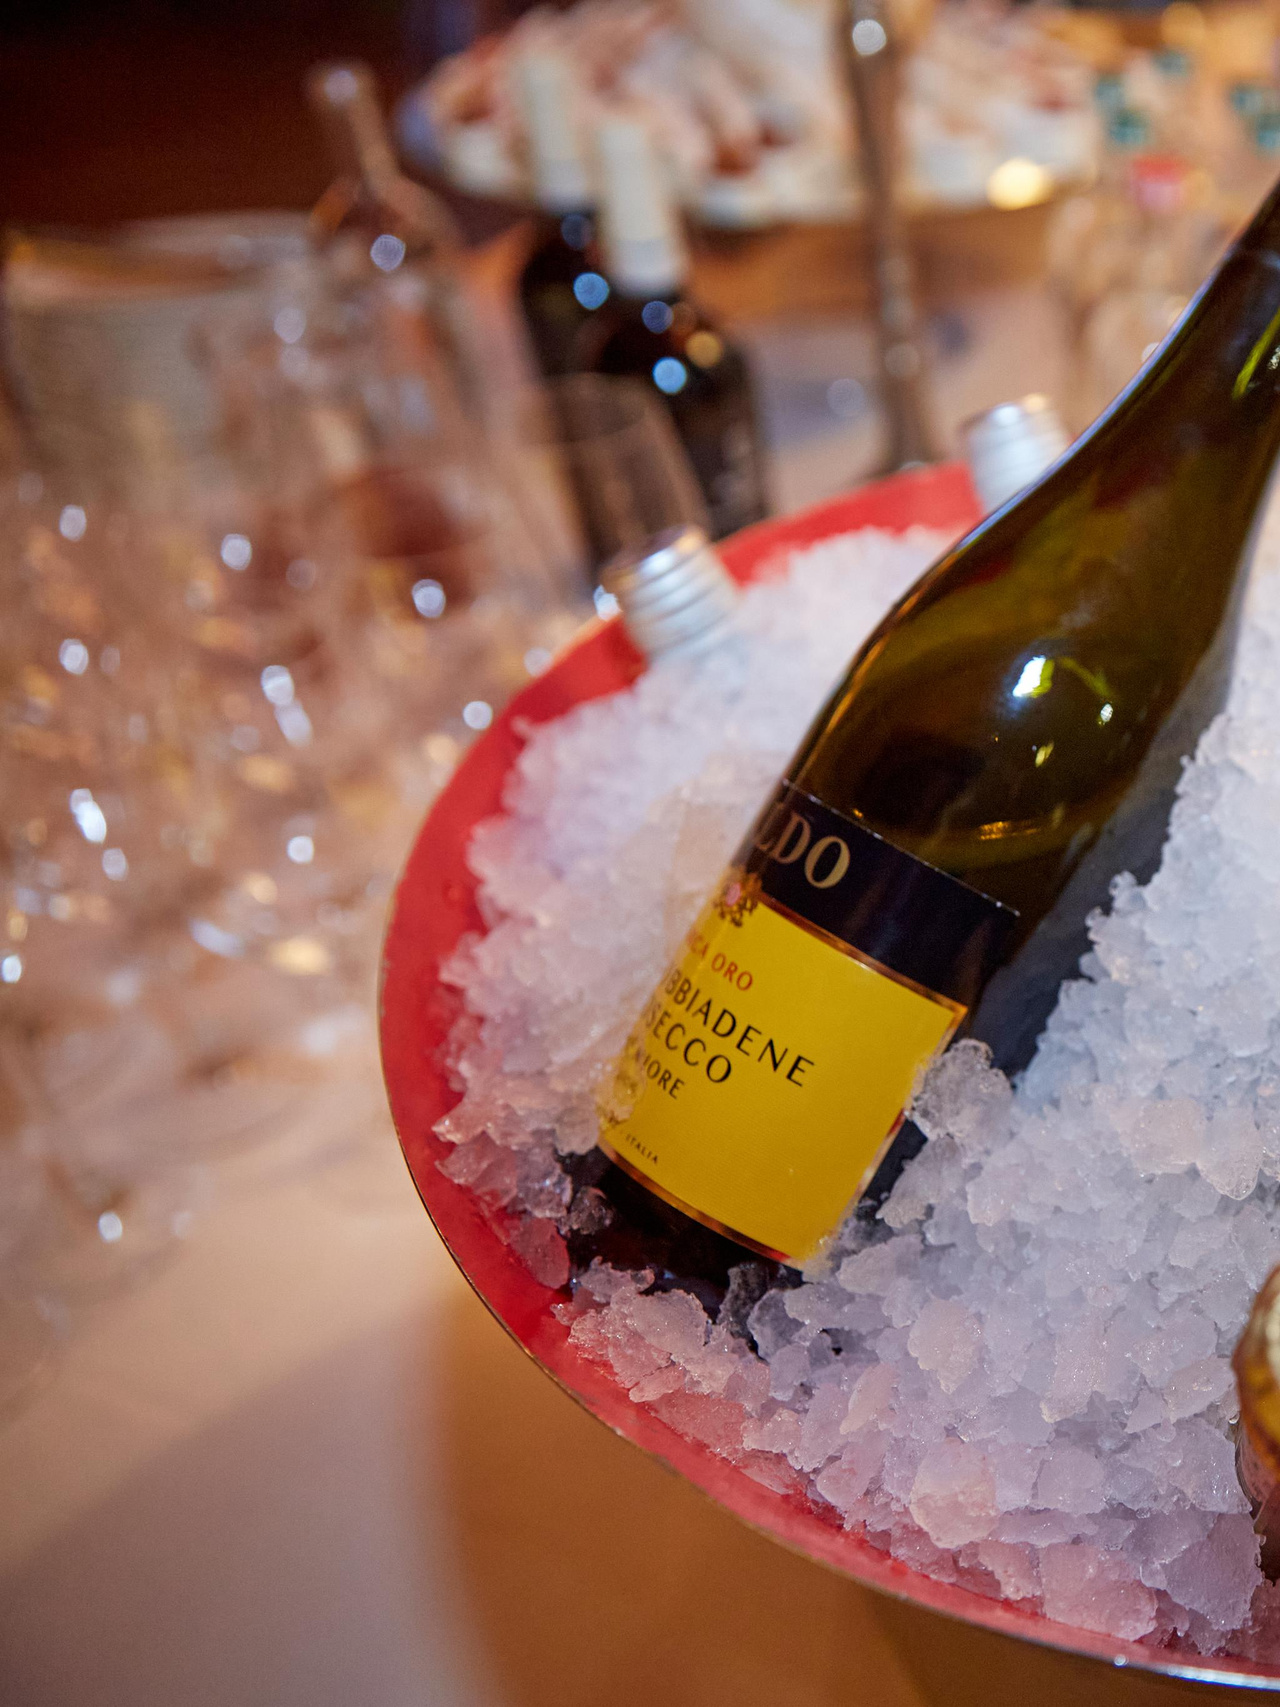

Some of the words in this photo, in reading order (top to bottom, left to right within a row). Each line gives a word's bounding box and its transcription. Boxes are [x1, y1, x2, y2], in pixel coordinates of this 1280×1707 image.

[711, 952, 754, 992] ORO
[635, 1047, 685, 1100] IORE
[625, 1132, 660, 1164] ITALIA
